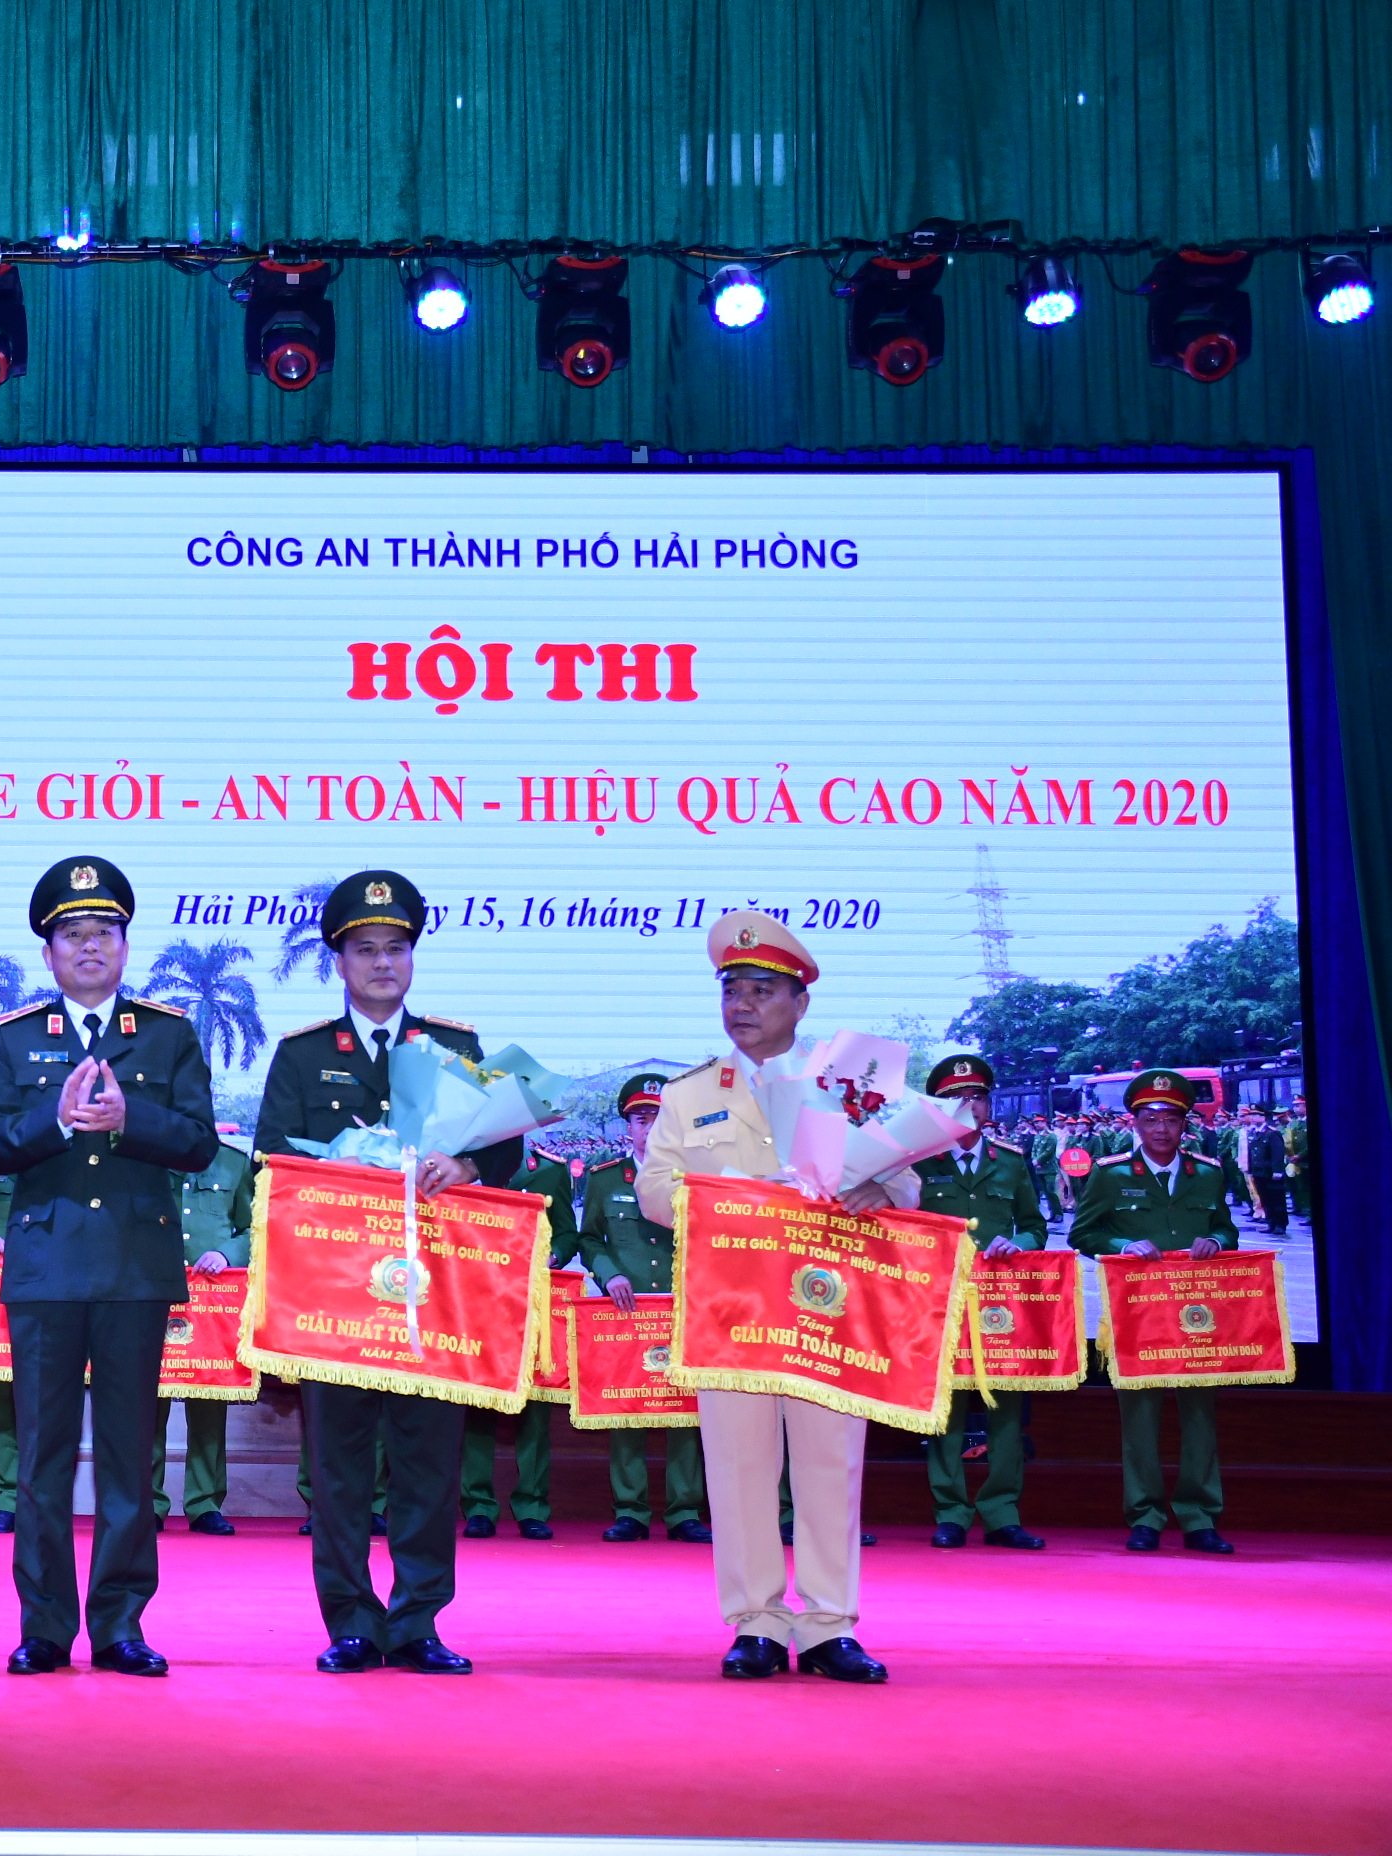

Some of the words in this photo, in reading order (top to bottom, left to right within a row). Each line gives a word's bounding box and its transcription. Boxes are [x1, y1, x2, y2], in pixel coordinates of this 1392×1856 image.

[187, 530, 304, 567] CÔNG
[315, 538, 369, 567] AN
[385, 531, 521, 568] THÀNH
[536, 531, 620, 568] PHỐ
[634, 531, 698, 568] HẢI
[715, 532, 858, 569] PHÒNG
[347, 623, 513, 715] HỘI
[535, 643, 698, 701] THI
[36, 759, 166, 820] GIỎI
[212, 775, 291, 822] AN
[307, 761, 466, 823] TOÀN
[517, 769, 660, 836] HIỆU
[677, 763, 802, 835] QUẢ
[819, 777, 942, 826] CAO
[959, 765, 1095, 827] NĂM
[1113, 778, 1228, 827] 2020
[171, 895, 234, 925] Hải
[459, 897, 504, 932] 15,
[518, 897, 556, 928] 16
[566, 898, 662, 937] tháng
[672, 898, 706, 928] 11
[802, 899, 880, 929] 2020
[298, 1188, 335, 1203] CÔNG
[338, 1194, 358, 1207] AN
[361, 1195, 406, 1212] THÀNH
[440, 1203, 464, 1221] HẢI
[468, 1211, 514, 1229] PHÒNG
[714, 1200, 752, 1215] CÔNG
[755, 1205, 775, 1217] AN
[780, 1209, 827, 1226] THÀNH
[830, 1216, 858, 1232] PHỐ
[860, 1220, 884, 1240] HẢI
[886, 1229, 936, 1249] PHÒNG
[295, 1224, 311, 1237] LÁI
[314, 1228, 328, 1239] XE
[332, 1227, 358, 1243] GIỎI
[369, 1234, 386, 1246] AN
[431, 1242, 455, 1258] HIỆU
[458, 1245, 482, 1260] QUẢ
[486, 1251, 511, 1265] CAO
[712, 1234, 729, 1248] LÁI
[732, 1237, 746, 1249] XE
[750, 1236, 777, 1250] GIỎI
[789, 1242, 806, 1255] AN
[808, 1245, 840, 1263] TOÀN
[850, 1255, 876, 1273] HIỆU
[878, 1263, 902, 1279] QUẢ
[905, 1270, 930, 1284] CAO
[784, 1225, 823, 1242] HỘI
[828, 1233, 865, 1253] THI
[296, 1310, 333, 1334] GIẢI
[337, 1316, 384, 1341] NHẤT
[438, 1333, 482, 1356] ĐOÀN
[376, 1306, 406, 1321] Tặn
[797, 1315, 834, 1335] Tặng
[360, 1347, 393, 1359] NĂM
[730, 1320, 763, 1343] GIẢI
[766, 1326, 798, 1347] NHÌ
[800, 1333, 842, 1360] TOÀN
[843, 1347, 890, 1374] ĐOÀN
[782, 1354, 812, 1368] NĂM
[814, 1362, 841, 1377] 2020
